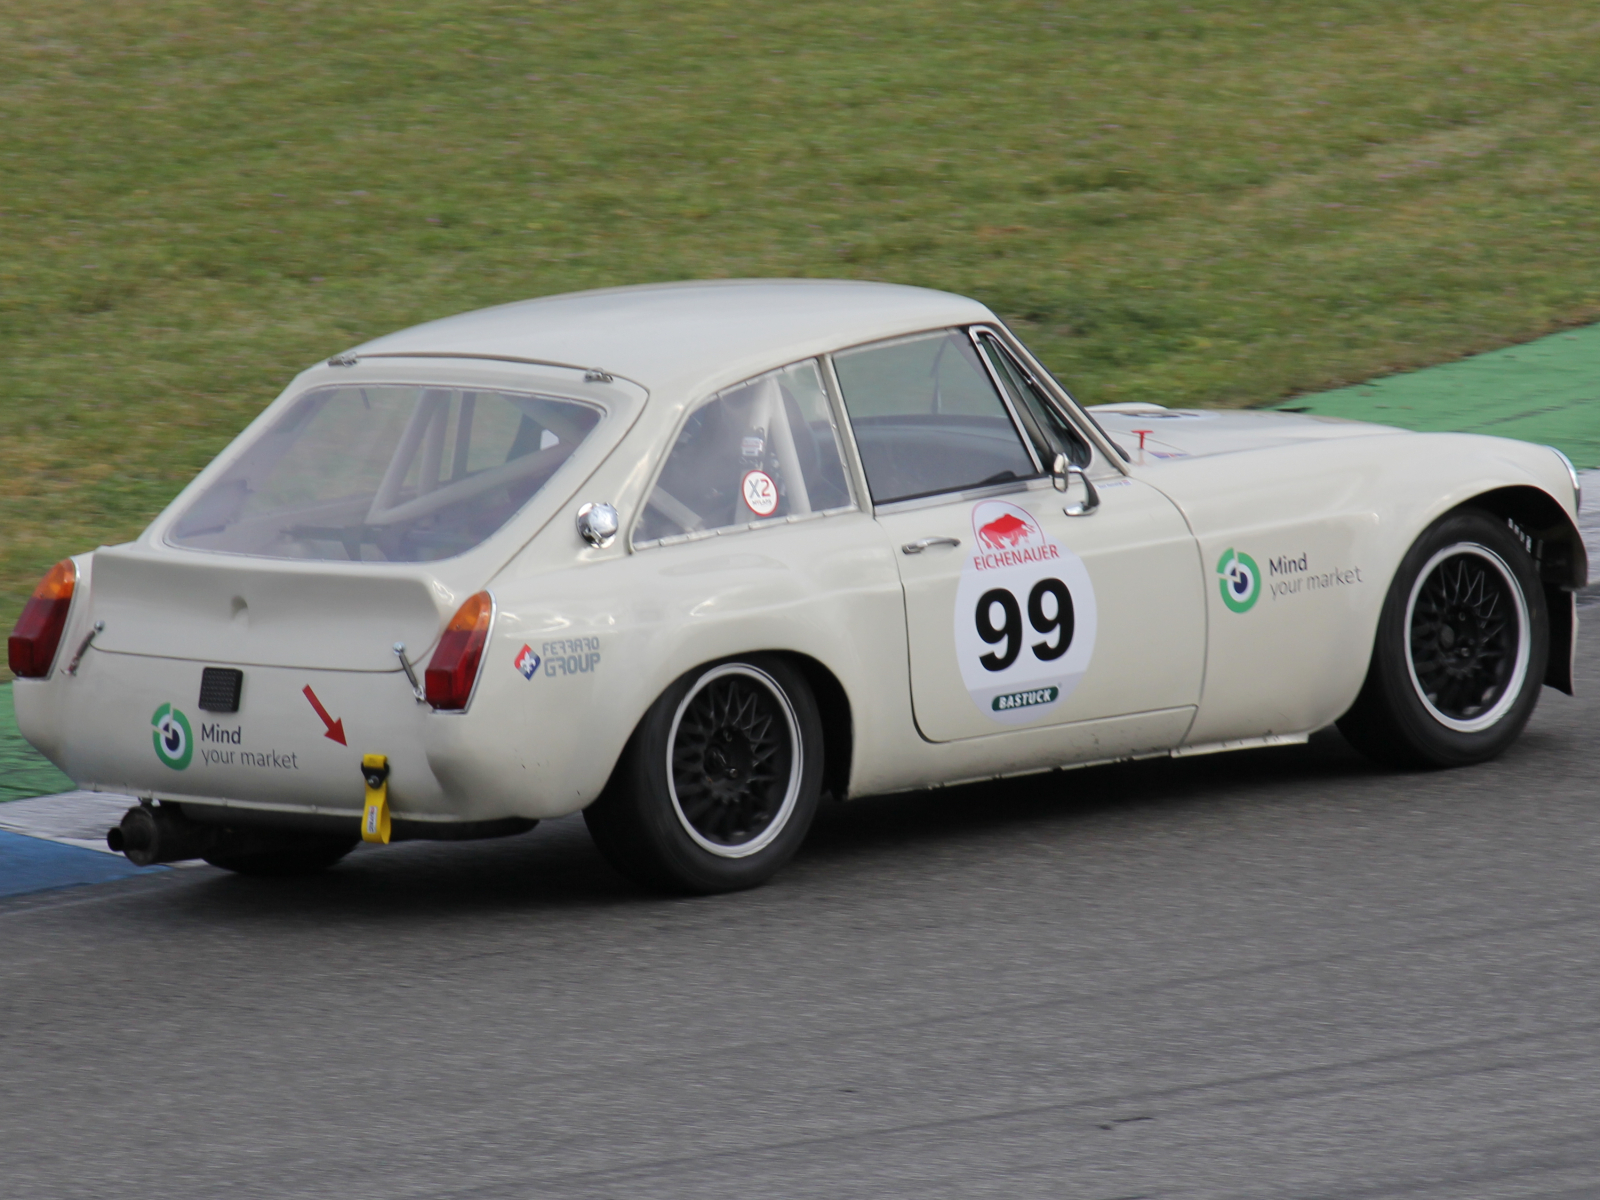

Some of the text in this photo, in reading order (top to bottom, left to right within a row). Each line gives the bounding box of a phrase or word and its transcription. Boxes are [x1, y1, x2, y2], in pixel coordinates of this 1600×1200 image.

[748, 478, 771, 498] X2
[973, 544, 1060, 571] EICHENAUER
[1269, 552, 1308, 577] Mind
[1269, 565, 1363, 601] your market
[975, 577, 1075, 673] 99
[542, 636, 600, 656] FERRARO
[544, 652, 601, 677] GROUP
[998, 688, 1052, 710] BASTUCK
[201, 722, 242, 745] Mind
[201, 748, 299, 770] your market
